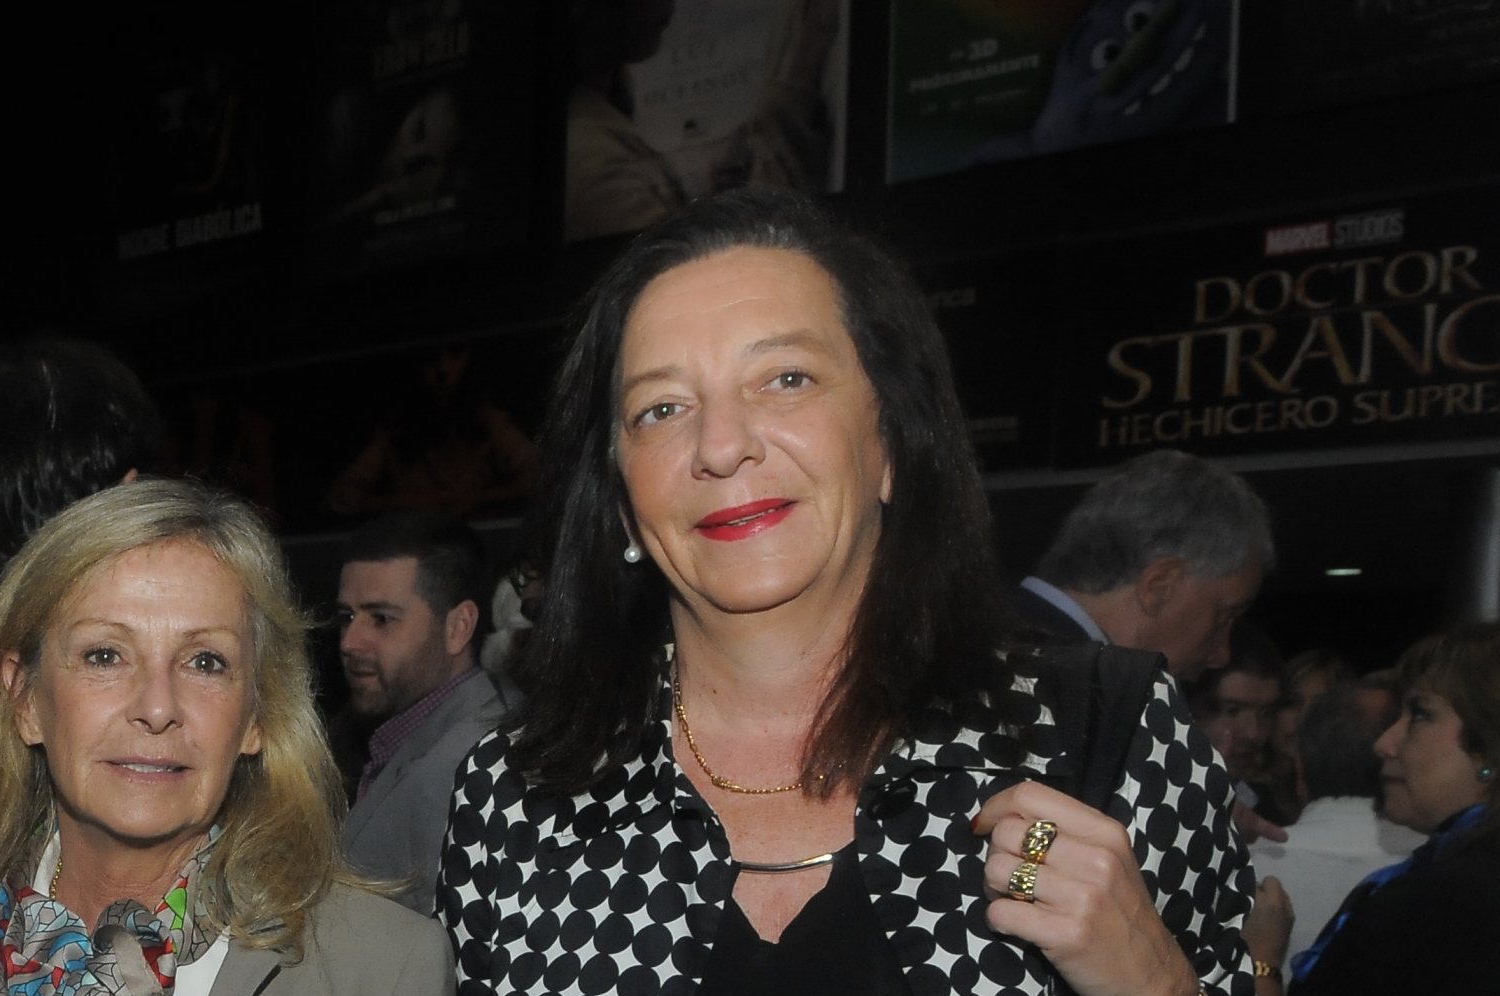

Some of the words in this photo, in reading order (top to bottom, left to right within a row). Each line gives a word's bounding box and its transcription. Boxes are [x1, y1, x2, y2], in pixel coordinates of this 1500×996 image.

[1266, 221, 1331, 256] MARVEL
[1334, 212, 1405, 247] STUDIOS
[1194, 245, 1483, 325] DOCTOR
[1098, 395, 1339, 447] HECHICERO
